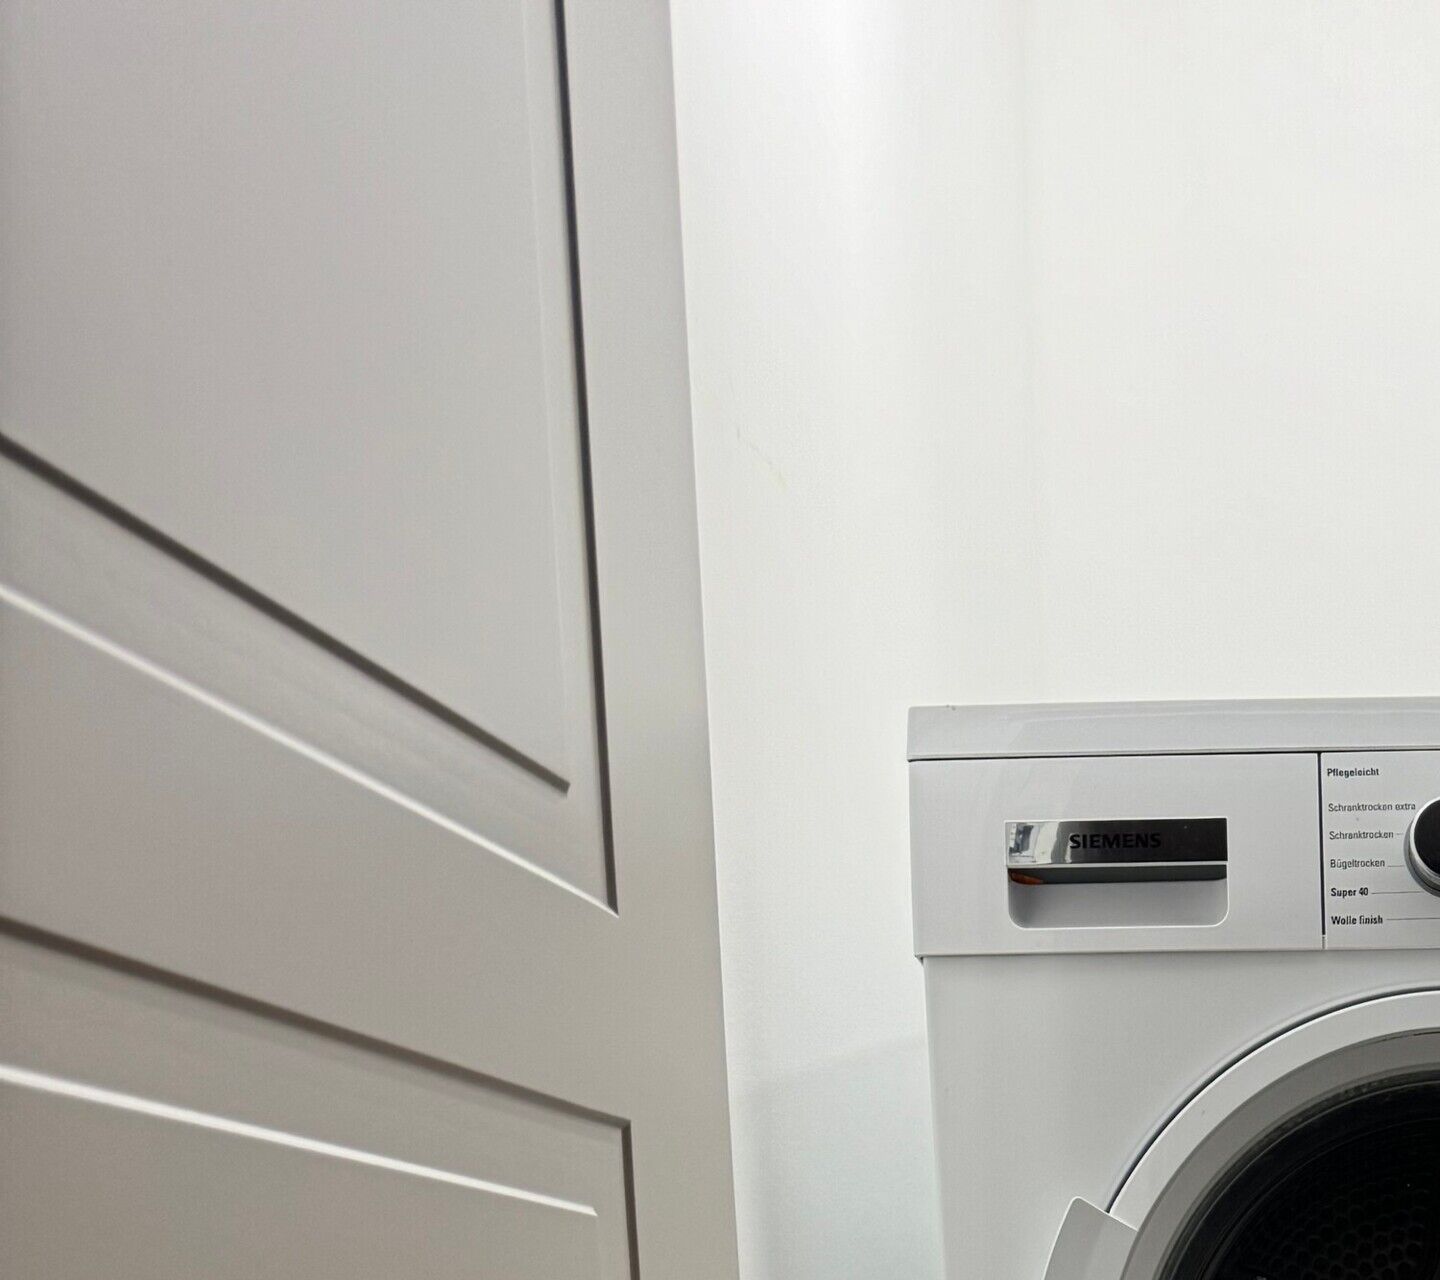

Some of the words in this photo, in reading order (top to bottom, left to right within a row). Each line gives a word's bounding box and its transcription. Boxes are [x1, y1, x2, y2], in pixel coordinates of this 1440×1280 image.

[1327, 768, 1380, 778] Pflegeleicht
[1328, 803, 1393, 812] Schranktrocken
[1395, 803, 1416, 811] extra
[1329, 831, 1394, 840] Schranktrocken
[1069, 832, 1161, 850] SIEMENS
[1330, 859, 1386, 870] Bügeltrocken
[1331, 887, 1357, 898] Super
[1359, 887, 1369, 896] 40
[1331, 916, 1357, 925] Wolle
[1359, 915, 1383, 924] finish
